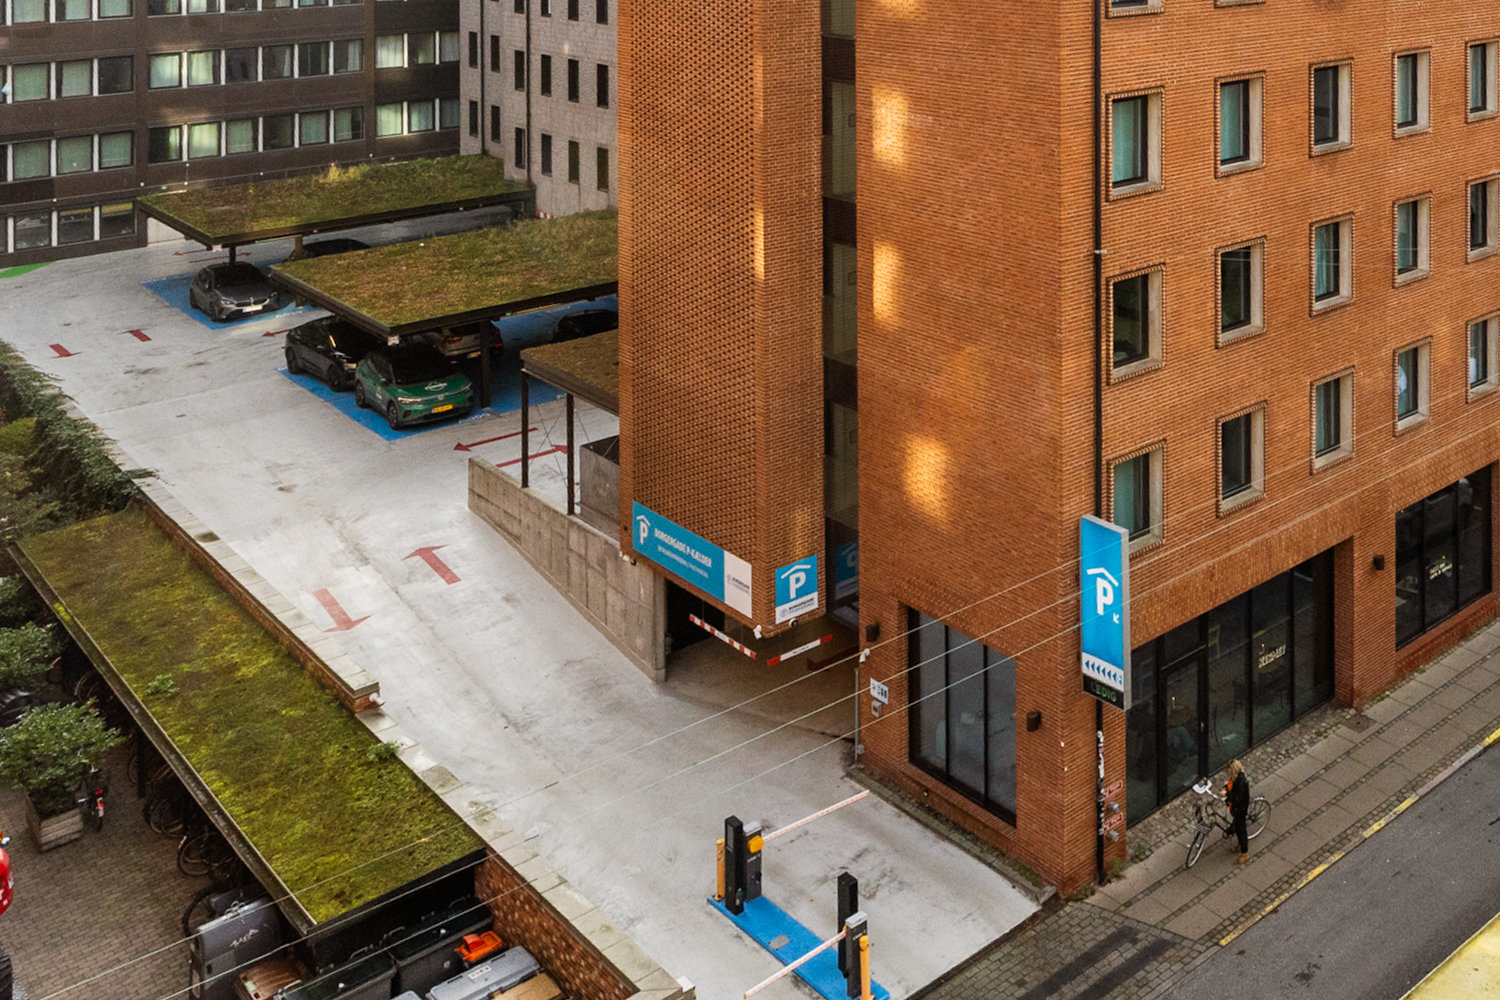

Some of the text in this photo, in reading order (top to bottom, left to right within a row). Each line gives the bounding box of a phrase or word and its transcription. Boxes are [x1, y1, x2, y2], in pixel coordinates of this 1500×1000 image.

[639, 520, 649, 545] P
[789, 570, 807, 600] P
[1096, 577, 1114, 616] P
